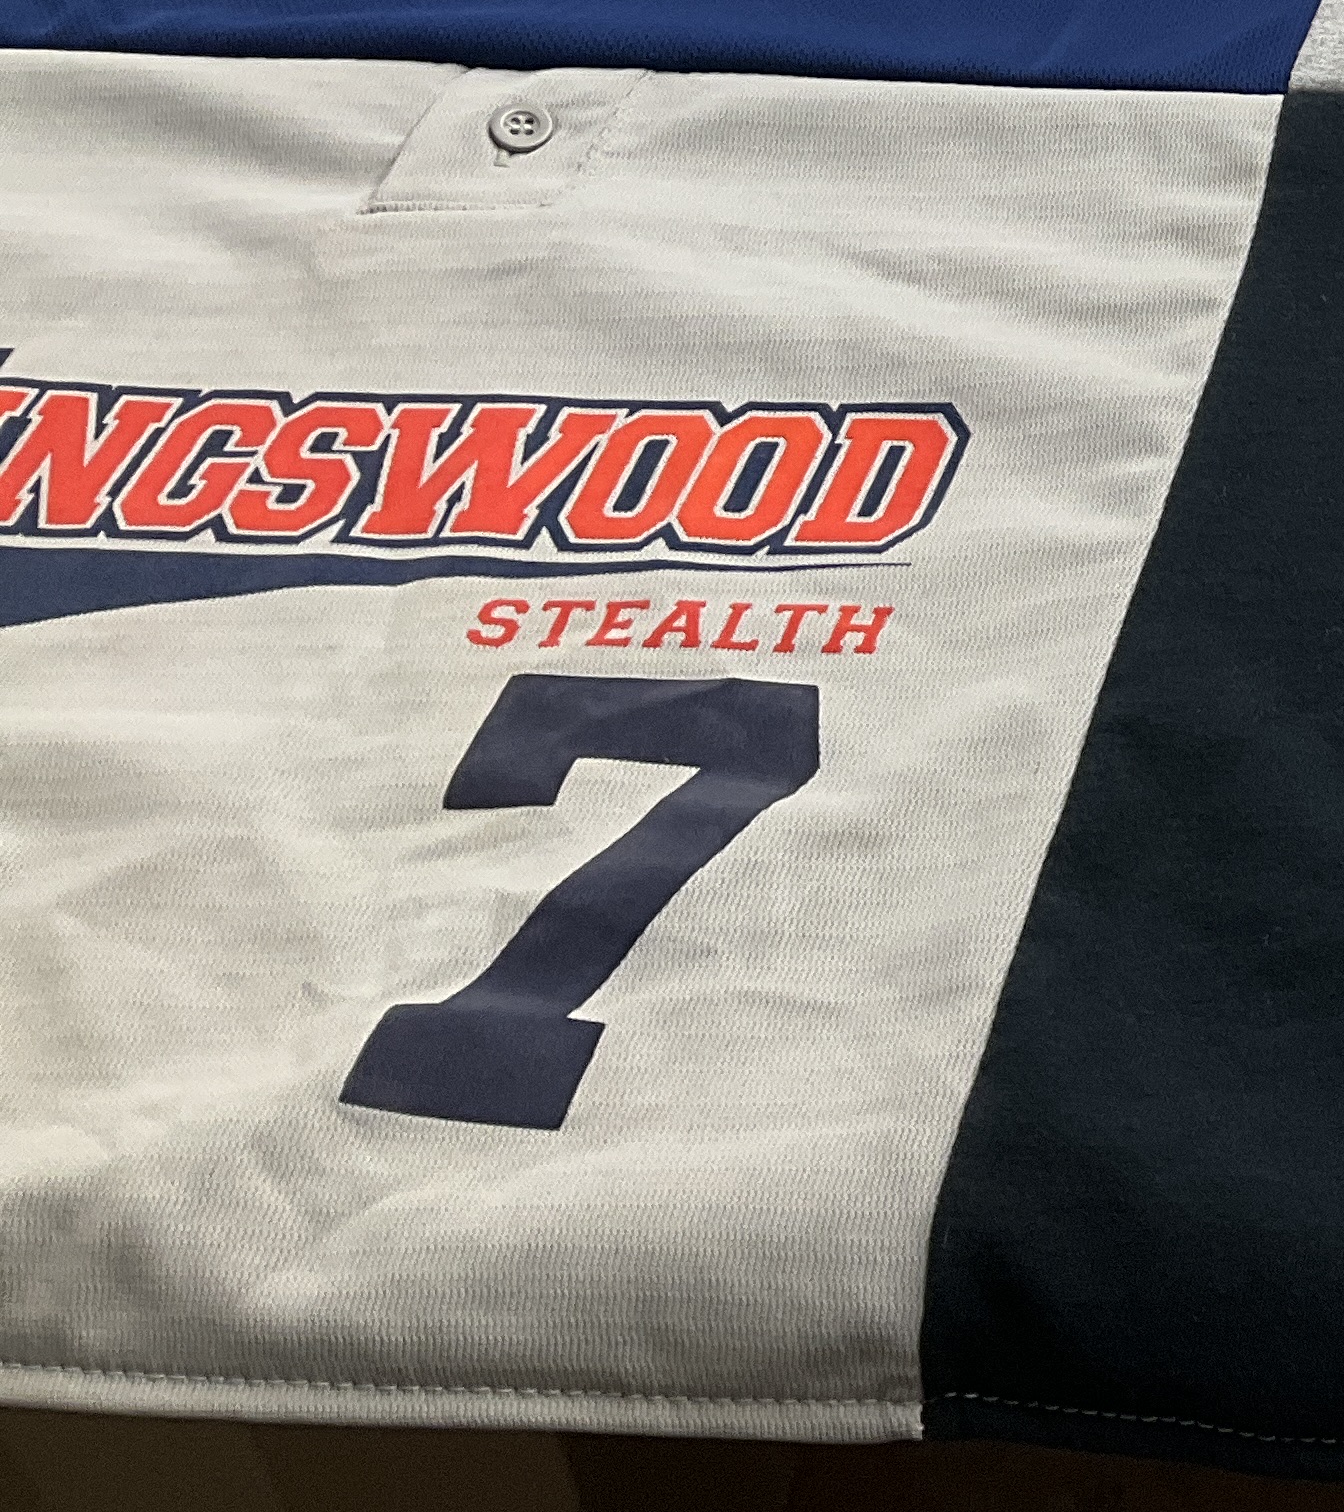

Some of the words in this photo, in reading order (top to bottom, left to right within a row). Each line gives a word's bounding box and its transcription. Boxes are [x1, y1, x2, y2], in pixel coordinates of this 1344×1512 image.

[0, 374, 972, 555] NGSWOOD
[466, 598, 895, 655] STEALTH
[338, 673, 822, 1131] 7
